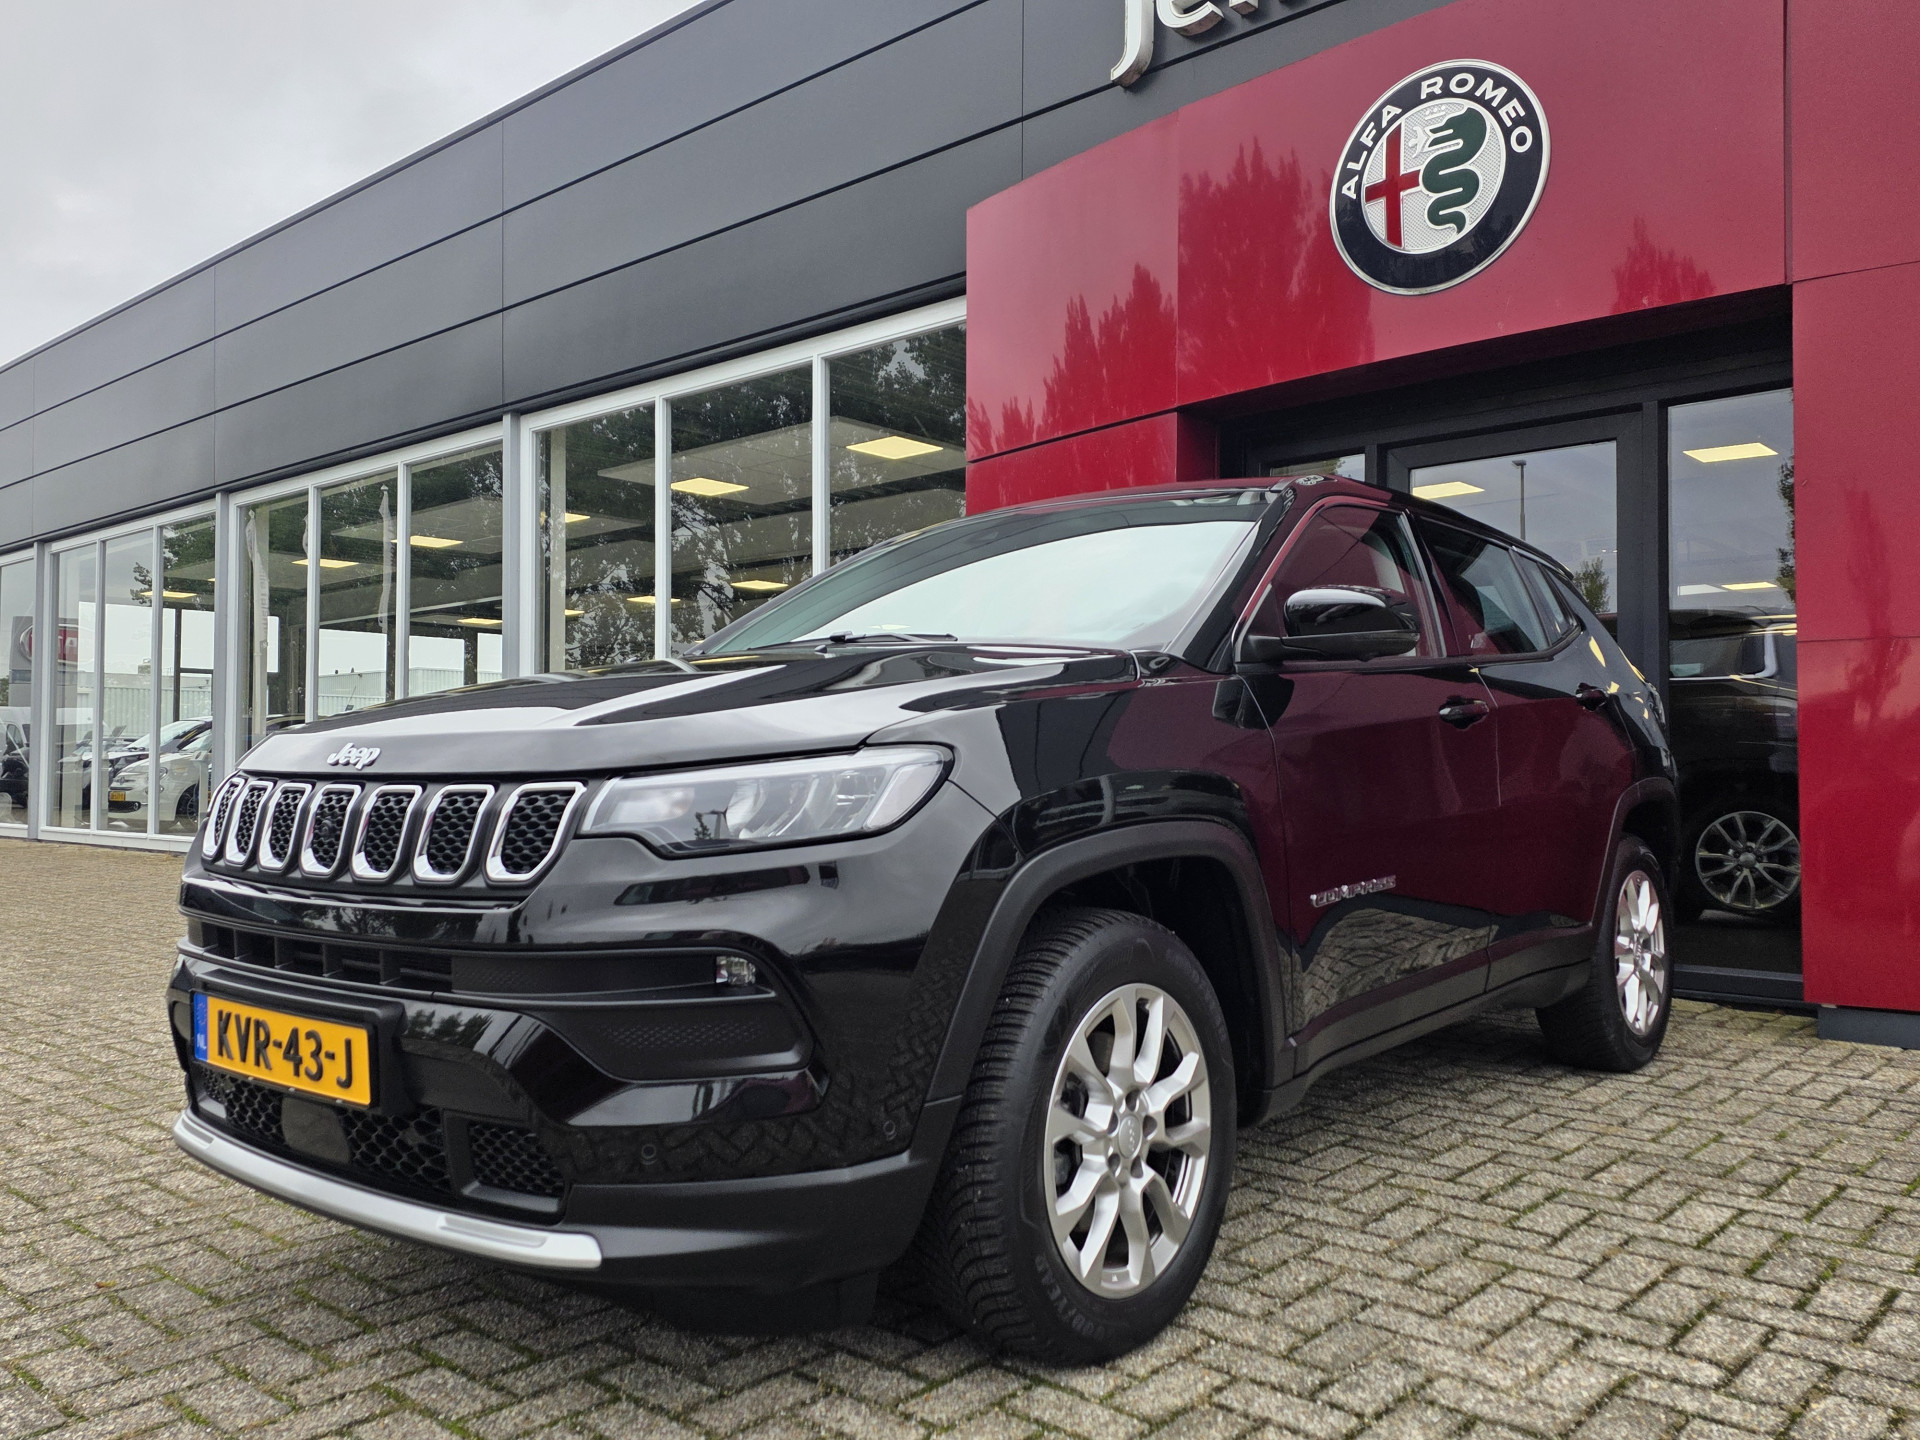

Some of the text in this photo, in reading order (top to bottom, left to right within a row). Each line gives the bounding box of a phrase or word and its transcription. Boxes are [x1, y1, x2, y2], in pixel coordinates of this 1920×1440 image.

[1341, 72, 1533, 200] ALFA ROMEO
[327, 742, 381, 770] Jeep
[217, 1009, 353, 1089] KVR-43-J
[1034, 1253, 1112, 1343] OODYEAR
